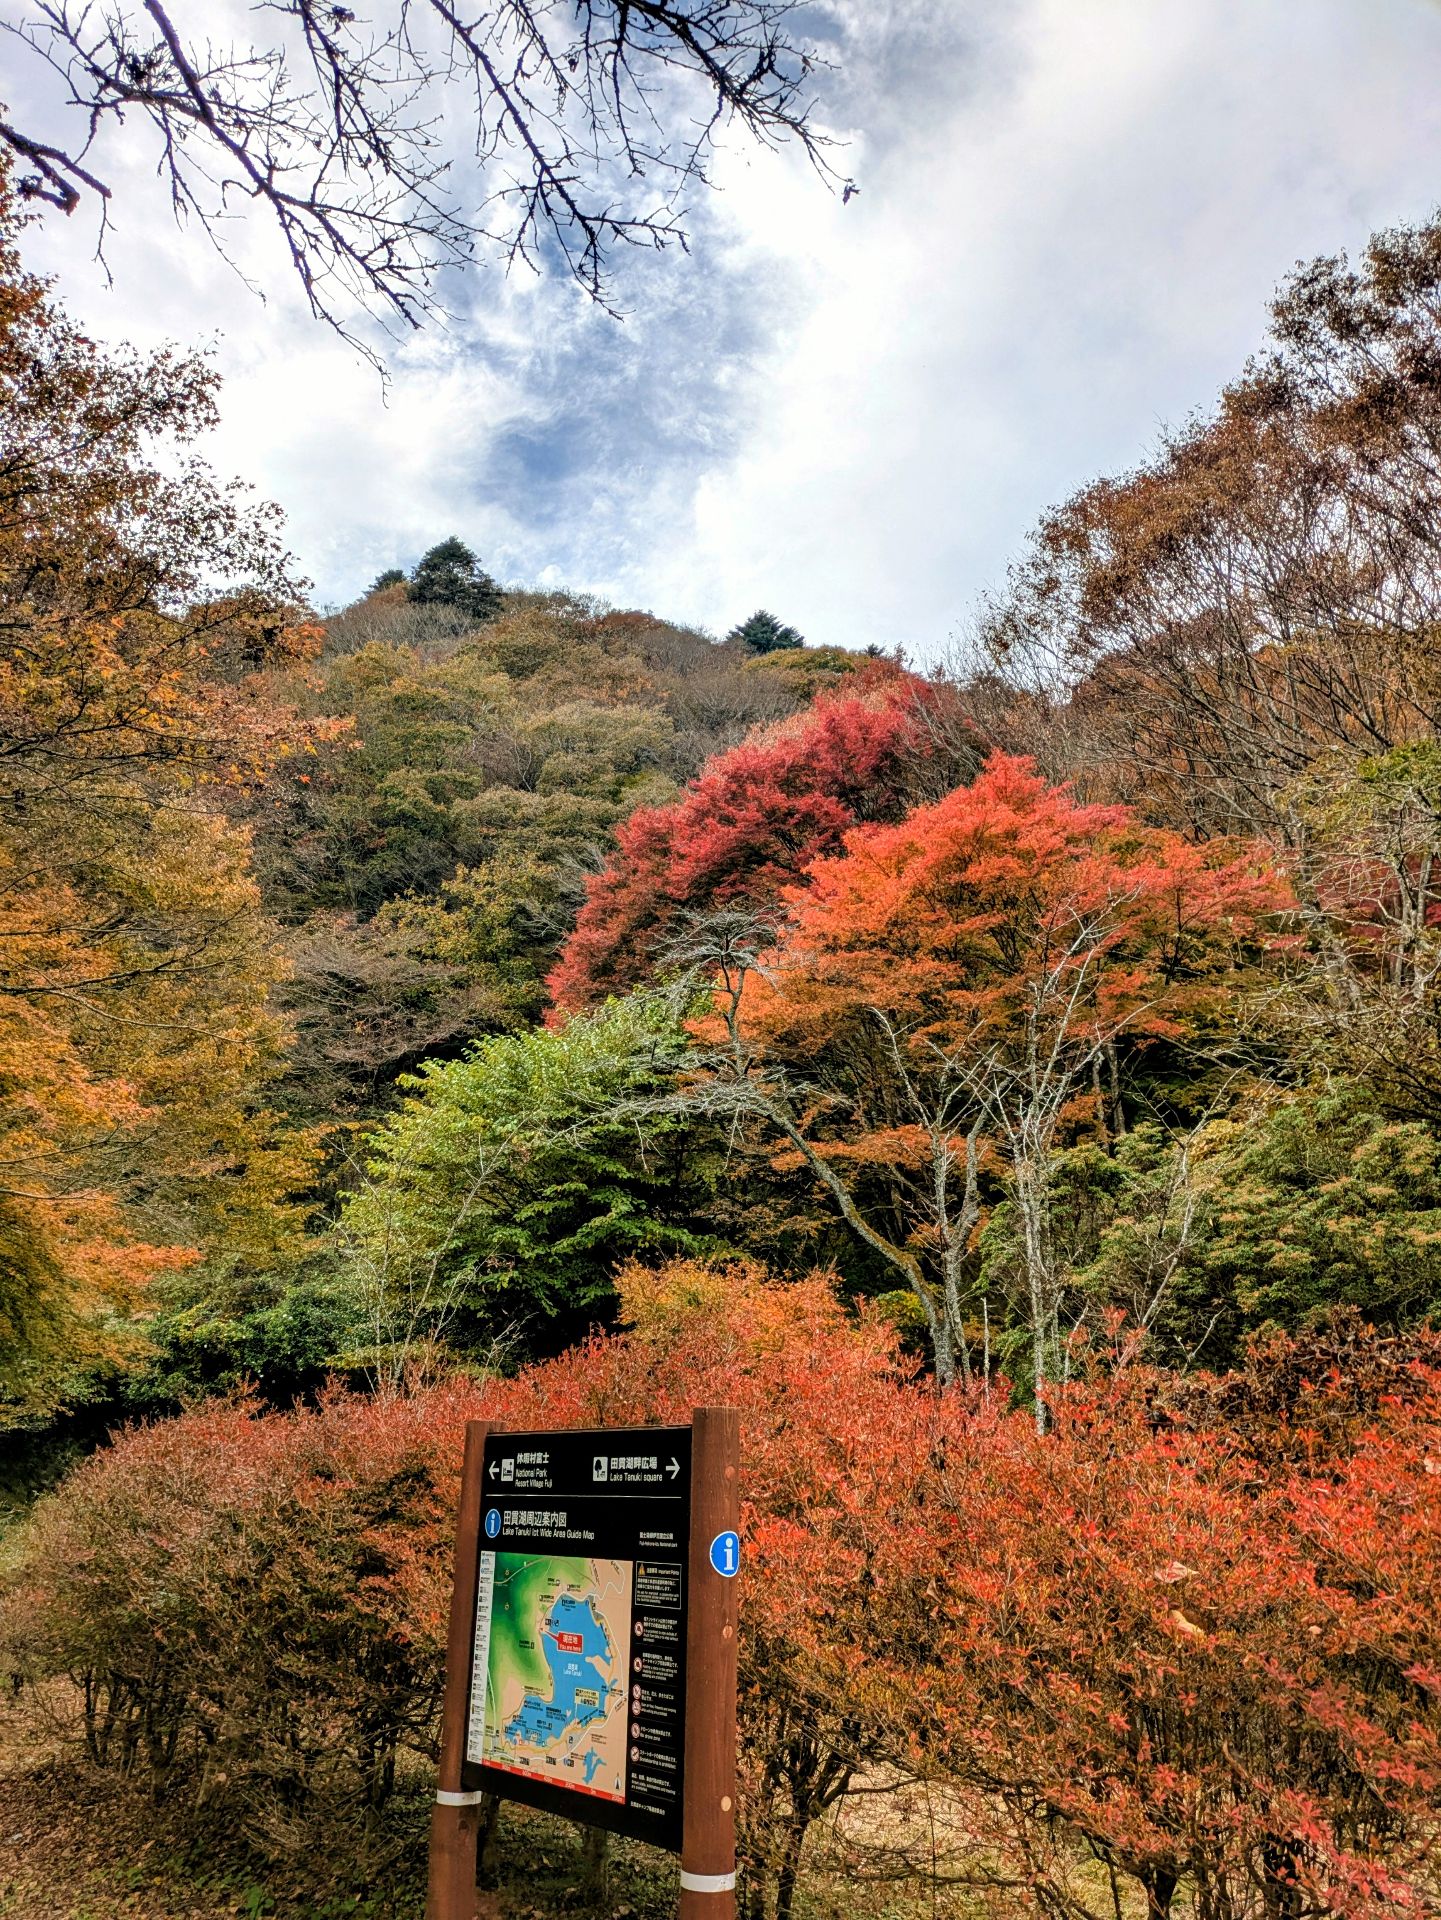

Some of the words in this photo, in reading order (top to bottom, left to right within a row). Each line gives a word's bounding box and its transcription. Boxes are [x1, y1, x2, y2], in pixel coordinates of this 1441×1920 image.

[517, 1452, 550, 1464] 休暇村富士
[610, 1457, 658, 1470] 田貫湖畔広場
[515, 1468, 535, 1478] National
[536, 1468, 548, 1478] Park
[609, 1472, 623, 1482] Lake
[624, 1472, 643, 1482] Tanuki
[643, 1473, 663, 1482] square
[515, 1479, 529, 1488] Resort
[529, 1479, 544, 1489] Village
[544, 1479, 553, 1489] Fuji
[502, 1526, 515, 1536] Lake
[515, 1527, 532, 1537] Tanuki
[540, 1528, 552, 1538] Wide
[552, 1529, 566, 1539] Area
[566, 1529, 582, 1539] Guide
[582, 1530, 595, 1541] Map
